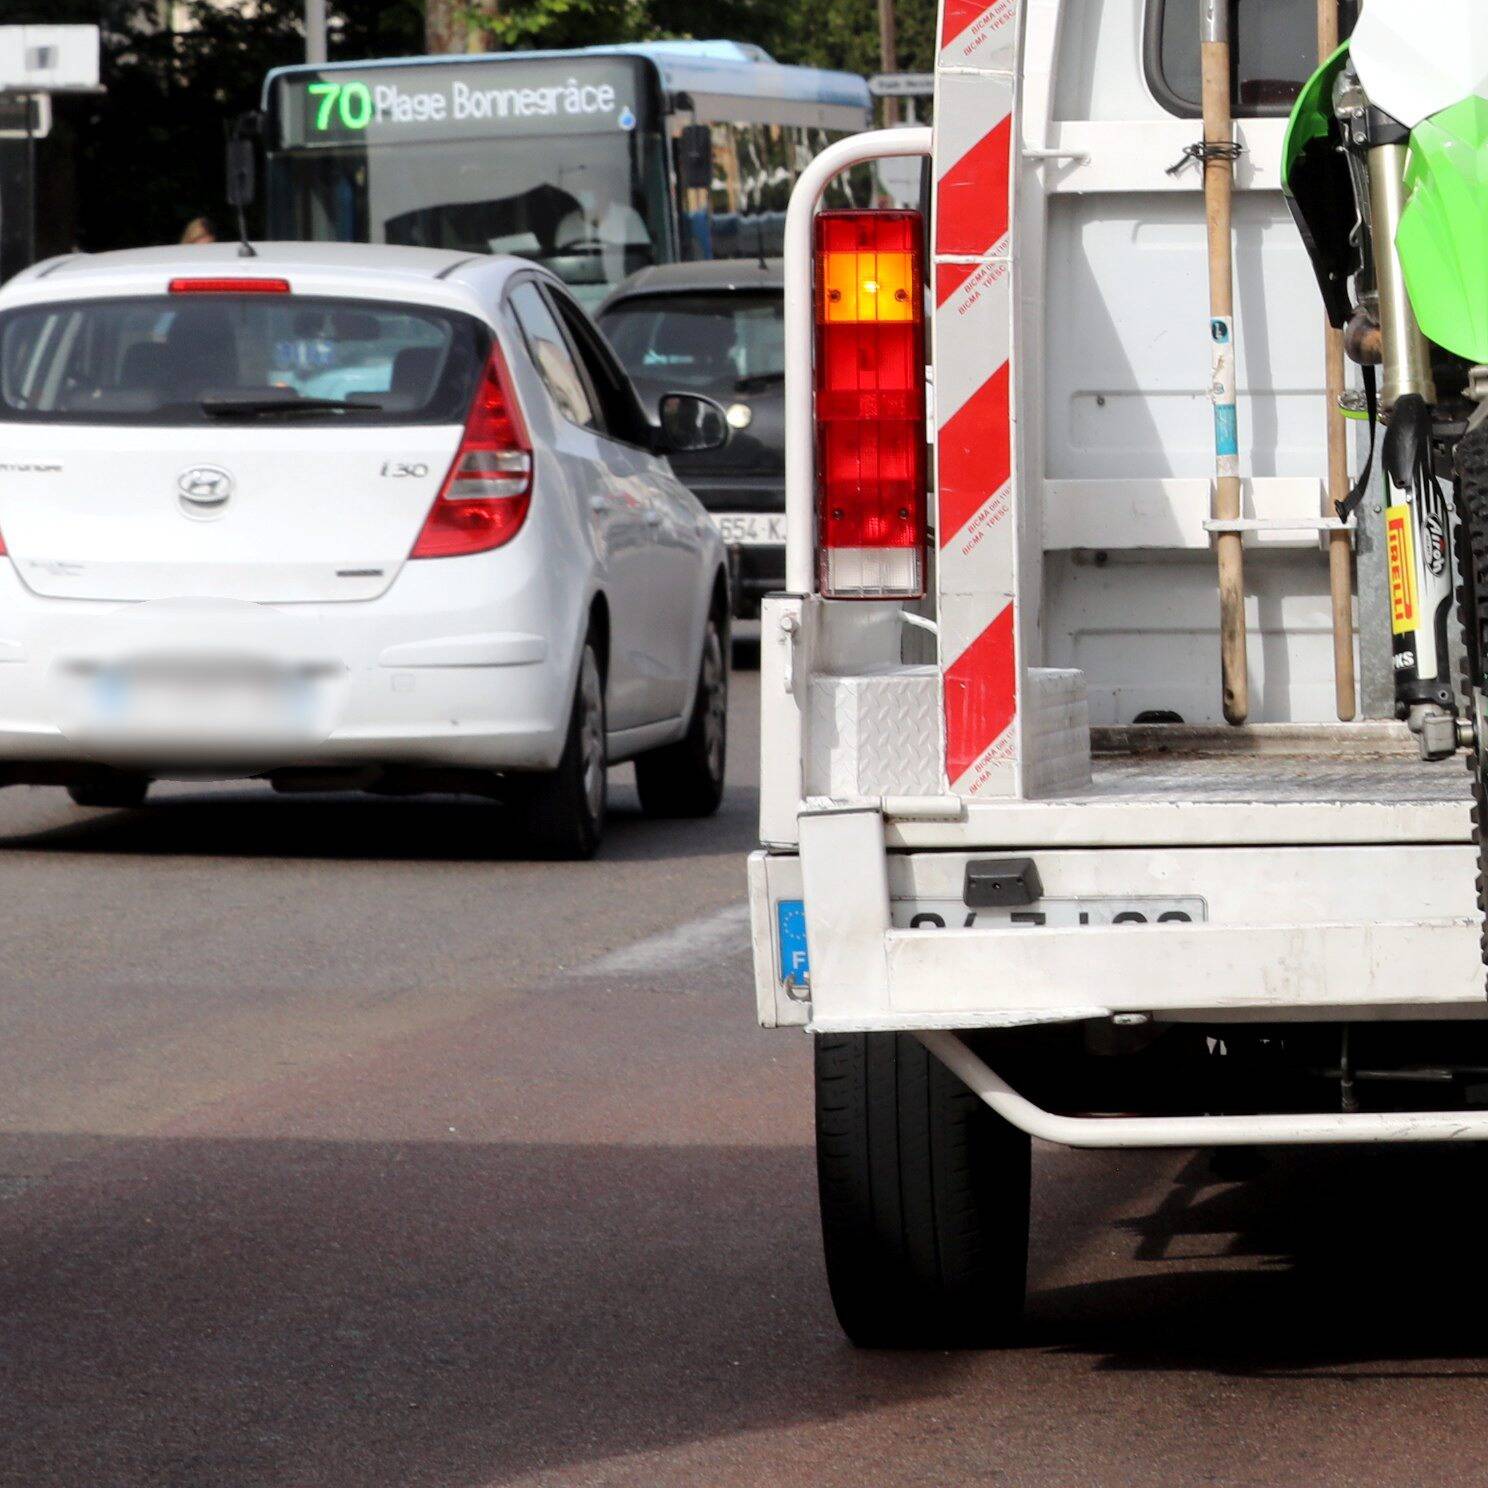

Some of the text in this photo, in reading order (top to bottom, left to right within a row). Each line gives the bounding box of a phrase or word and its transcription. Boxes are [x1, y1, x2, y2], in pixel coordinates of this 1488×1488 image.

[308, 78, 615, 131] 70 Plage Bonnegrâce
[1388, 518, 1413, 621] PIRELLI
